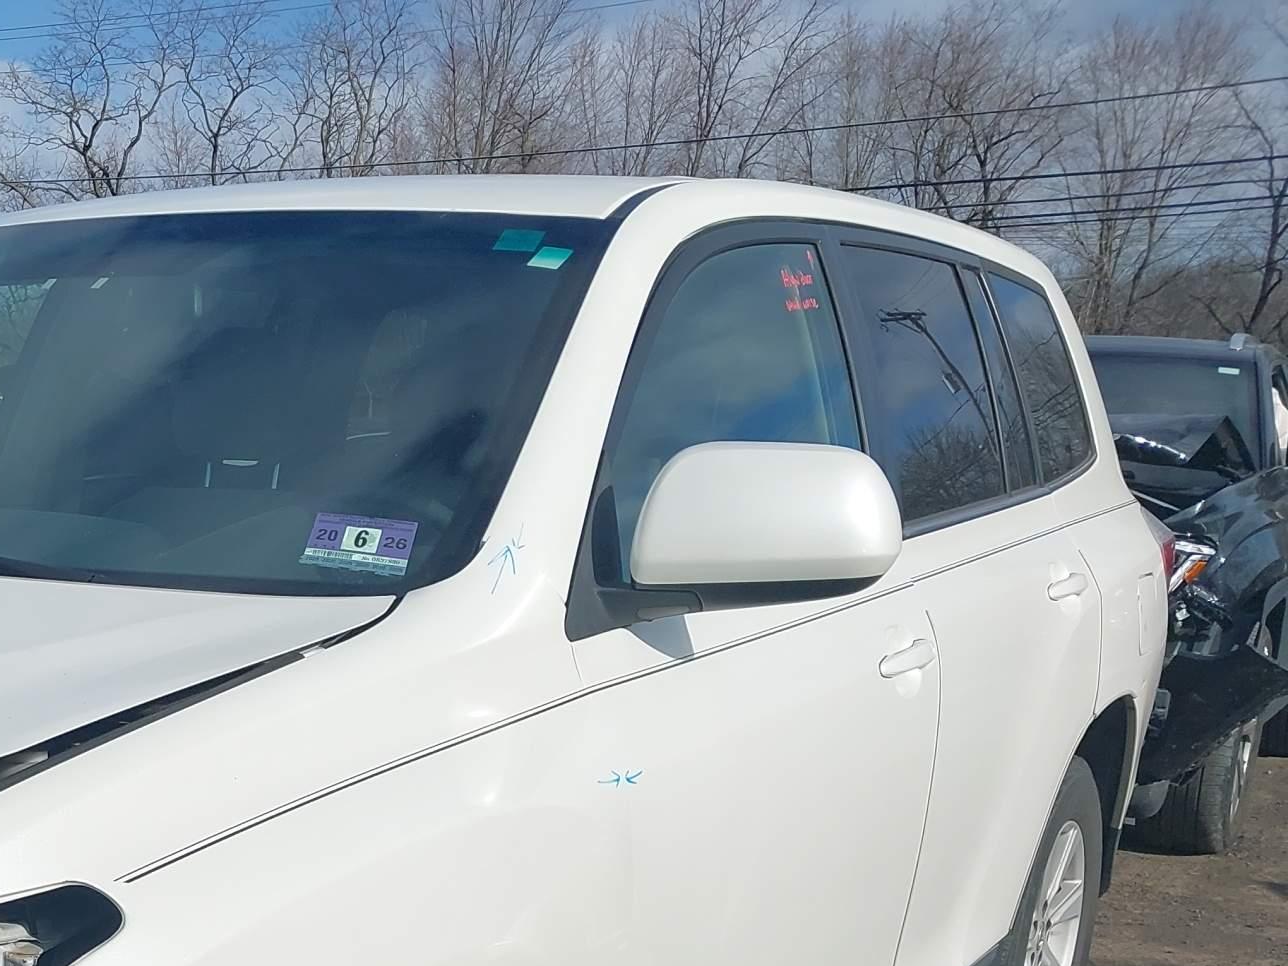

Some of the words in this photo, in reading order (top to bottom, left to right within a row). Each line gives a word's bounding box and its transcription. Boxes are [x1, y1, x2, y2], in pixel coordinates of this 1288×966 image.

[315, 528, 338, 542] 20
[353, 529, 369, 549] 6
[383, 536, 408, 550] 26
